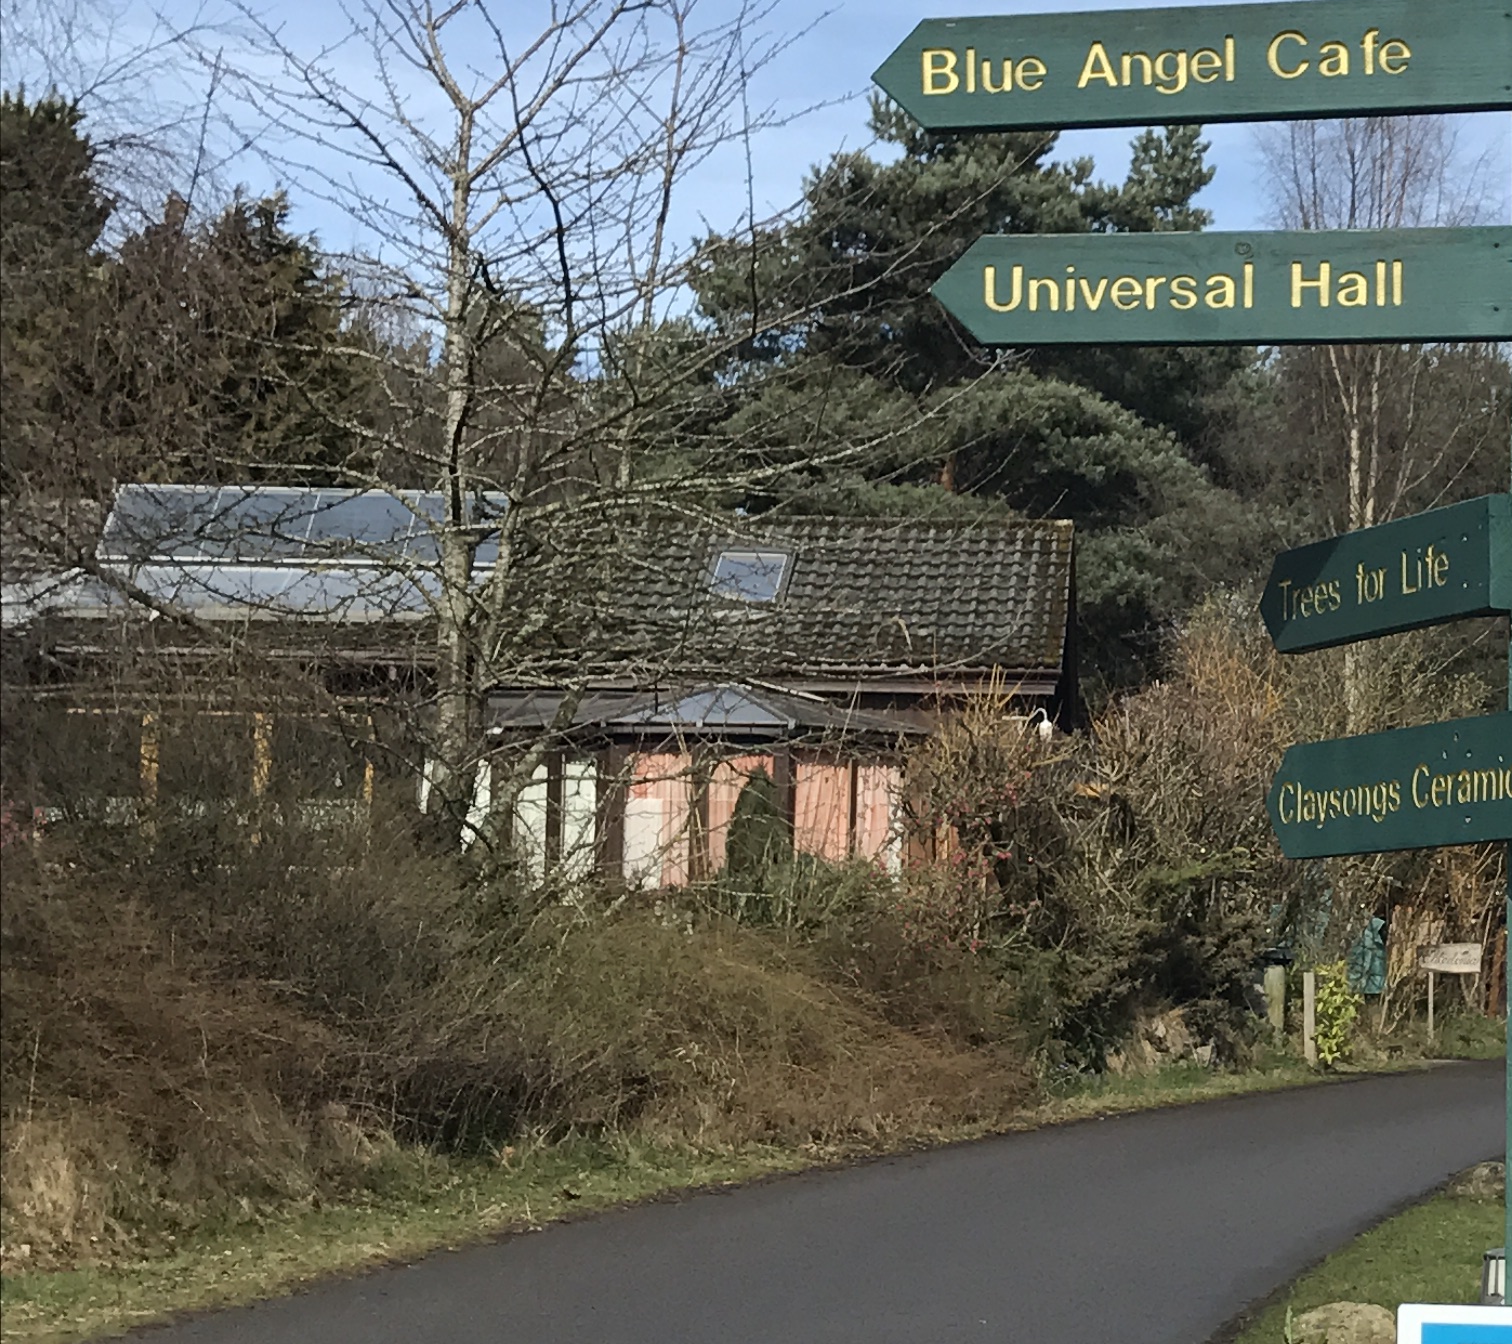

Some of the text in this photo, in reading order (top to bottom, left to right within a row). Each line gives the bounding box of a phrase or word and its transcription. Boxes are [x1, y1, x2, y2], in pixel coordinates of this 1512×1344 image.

[920, 28, 1412, 96] Blue Angel Cafe
[983, 259, 1404, 314] Universal Hall
[1278, 544, 1450, 622] Trees for Life
[1278, 779, 1402, 829] Claysongs
